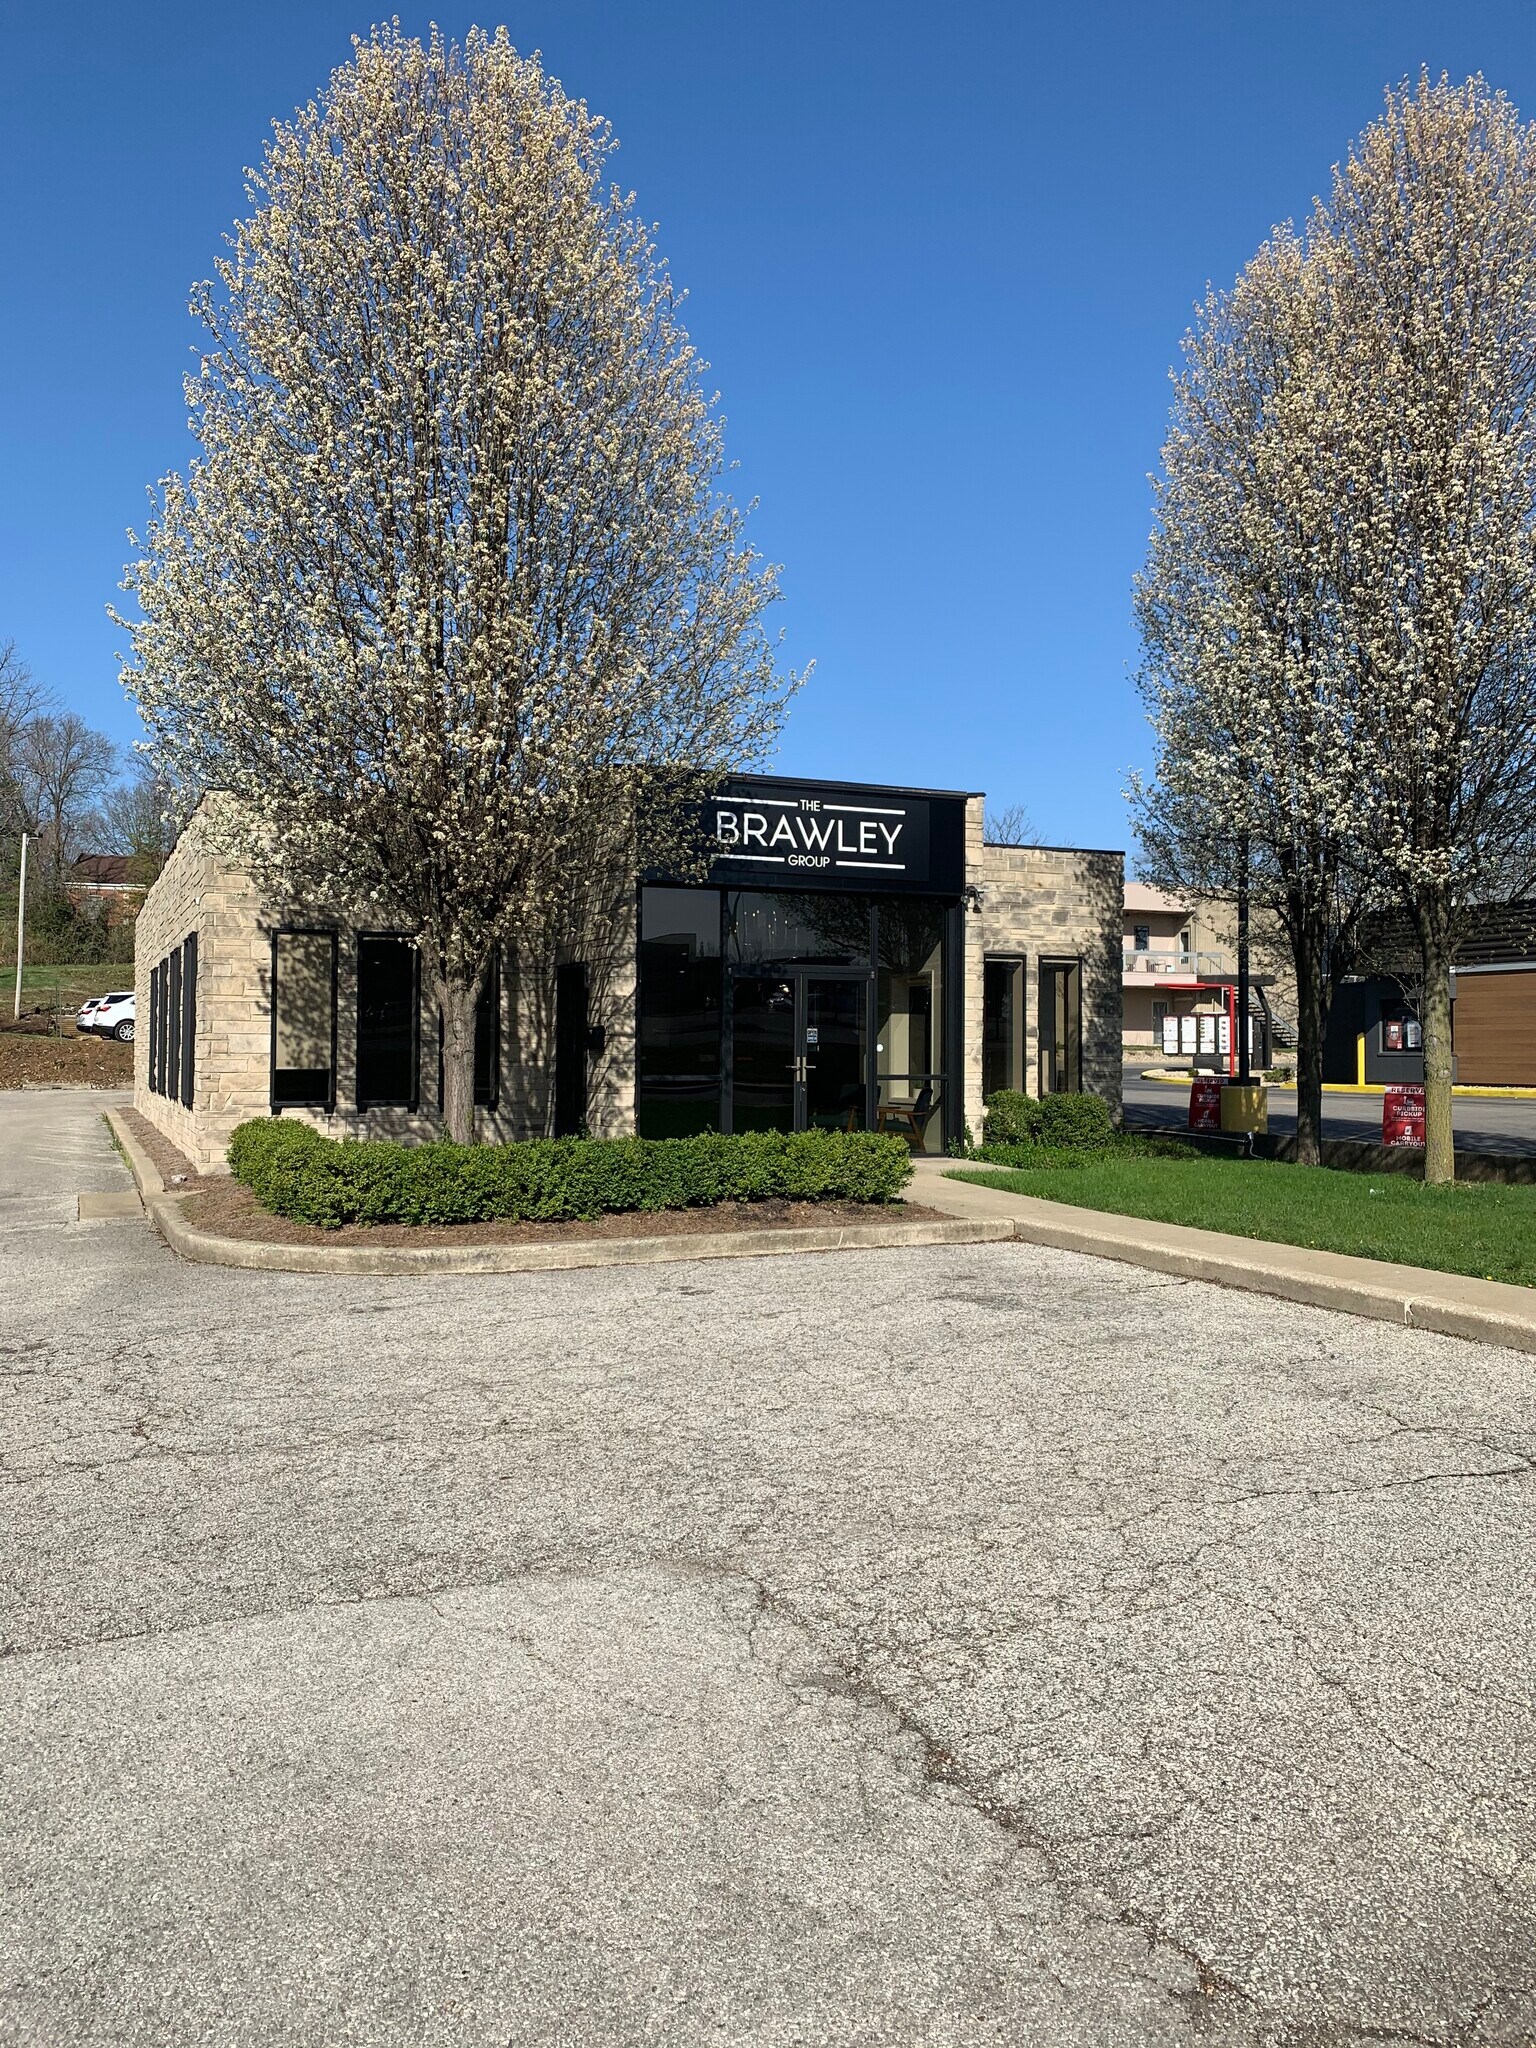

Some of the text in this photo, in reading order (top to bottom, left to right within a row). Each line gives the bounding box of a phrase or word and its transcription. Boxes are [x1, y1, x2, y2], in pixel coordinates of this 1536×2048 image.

[800, 799, 821, 812] THE
[716, 811, 903, 855] BRAWLEY
[787, 854, 831, 868] GROUP
